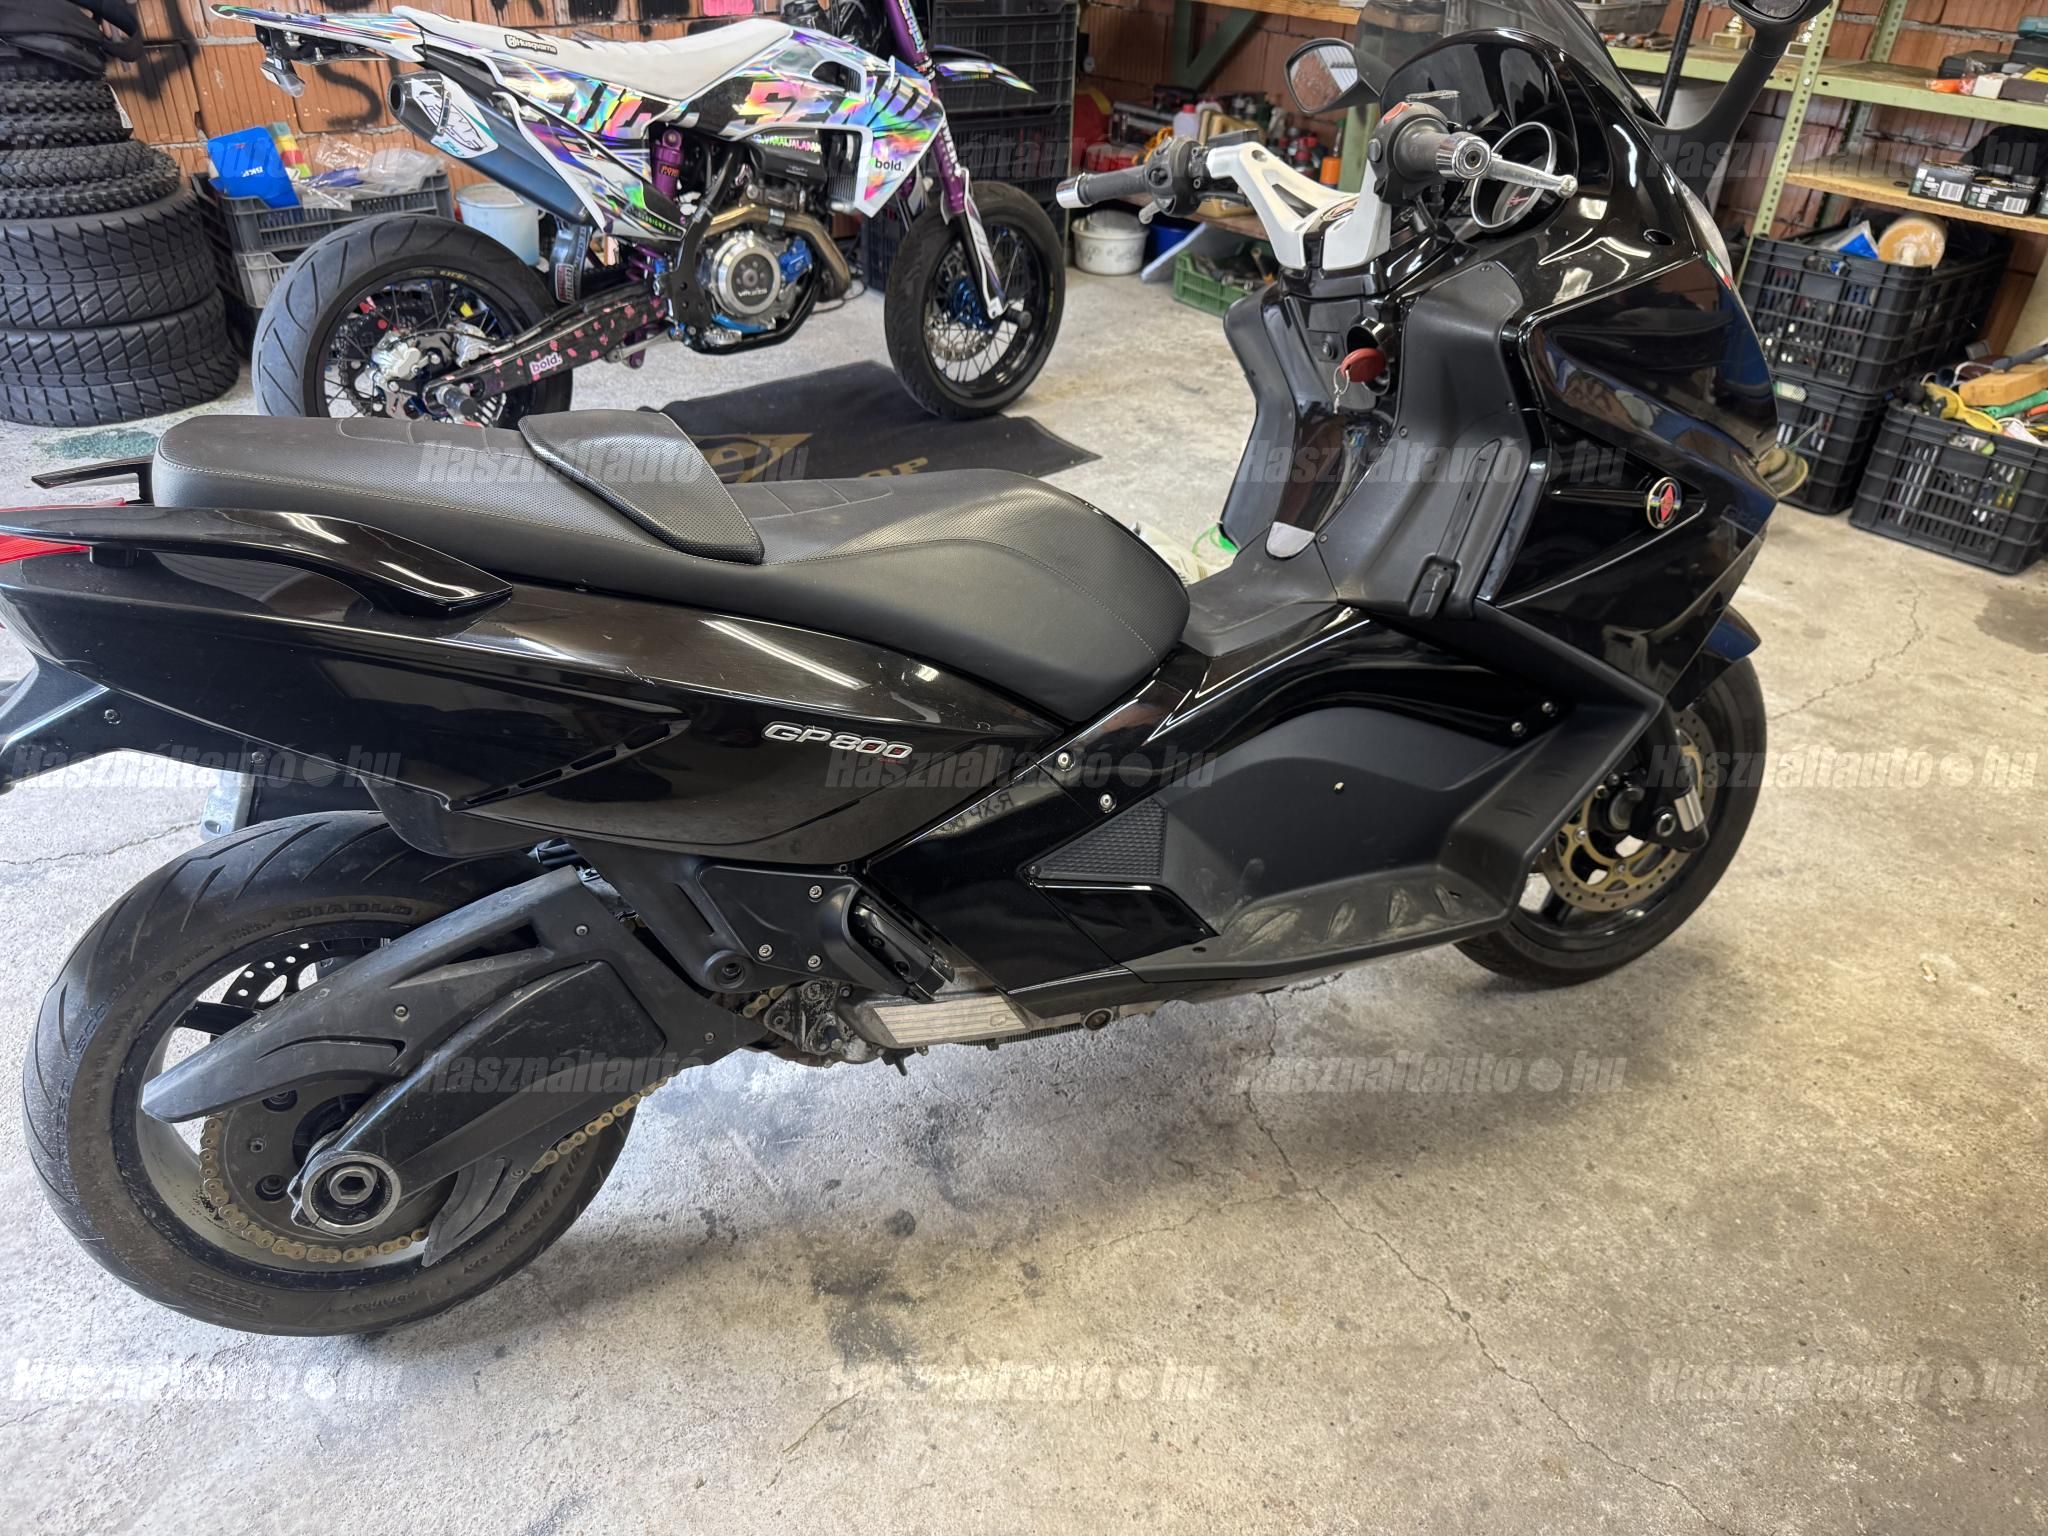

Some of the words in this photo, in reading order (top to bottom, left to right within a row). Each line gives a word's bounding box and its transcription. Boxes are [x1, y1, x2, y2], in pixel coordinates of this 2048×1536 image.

[875, 158, 904, 172] bold.
[532, 354, 562, 373] bold.
[763, 723, 913, 759] GP800
